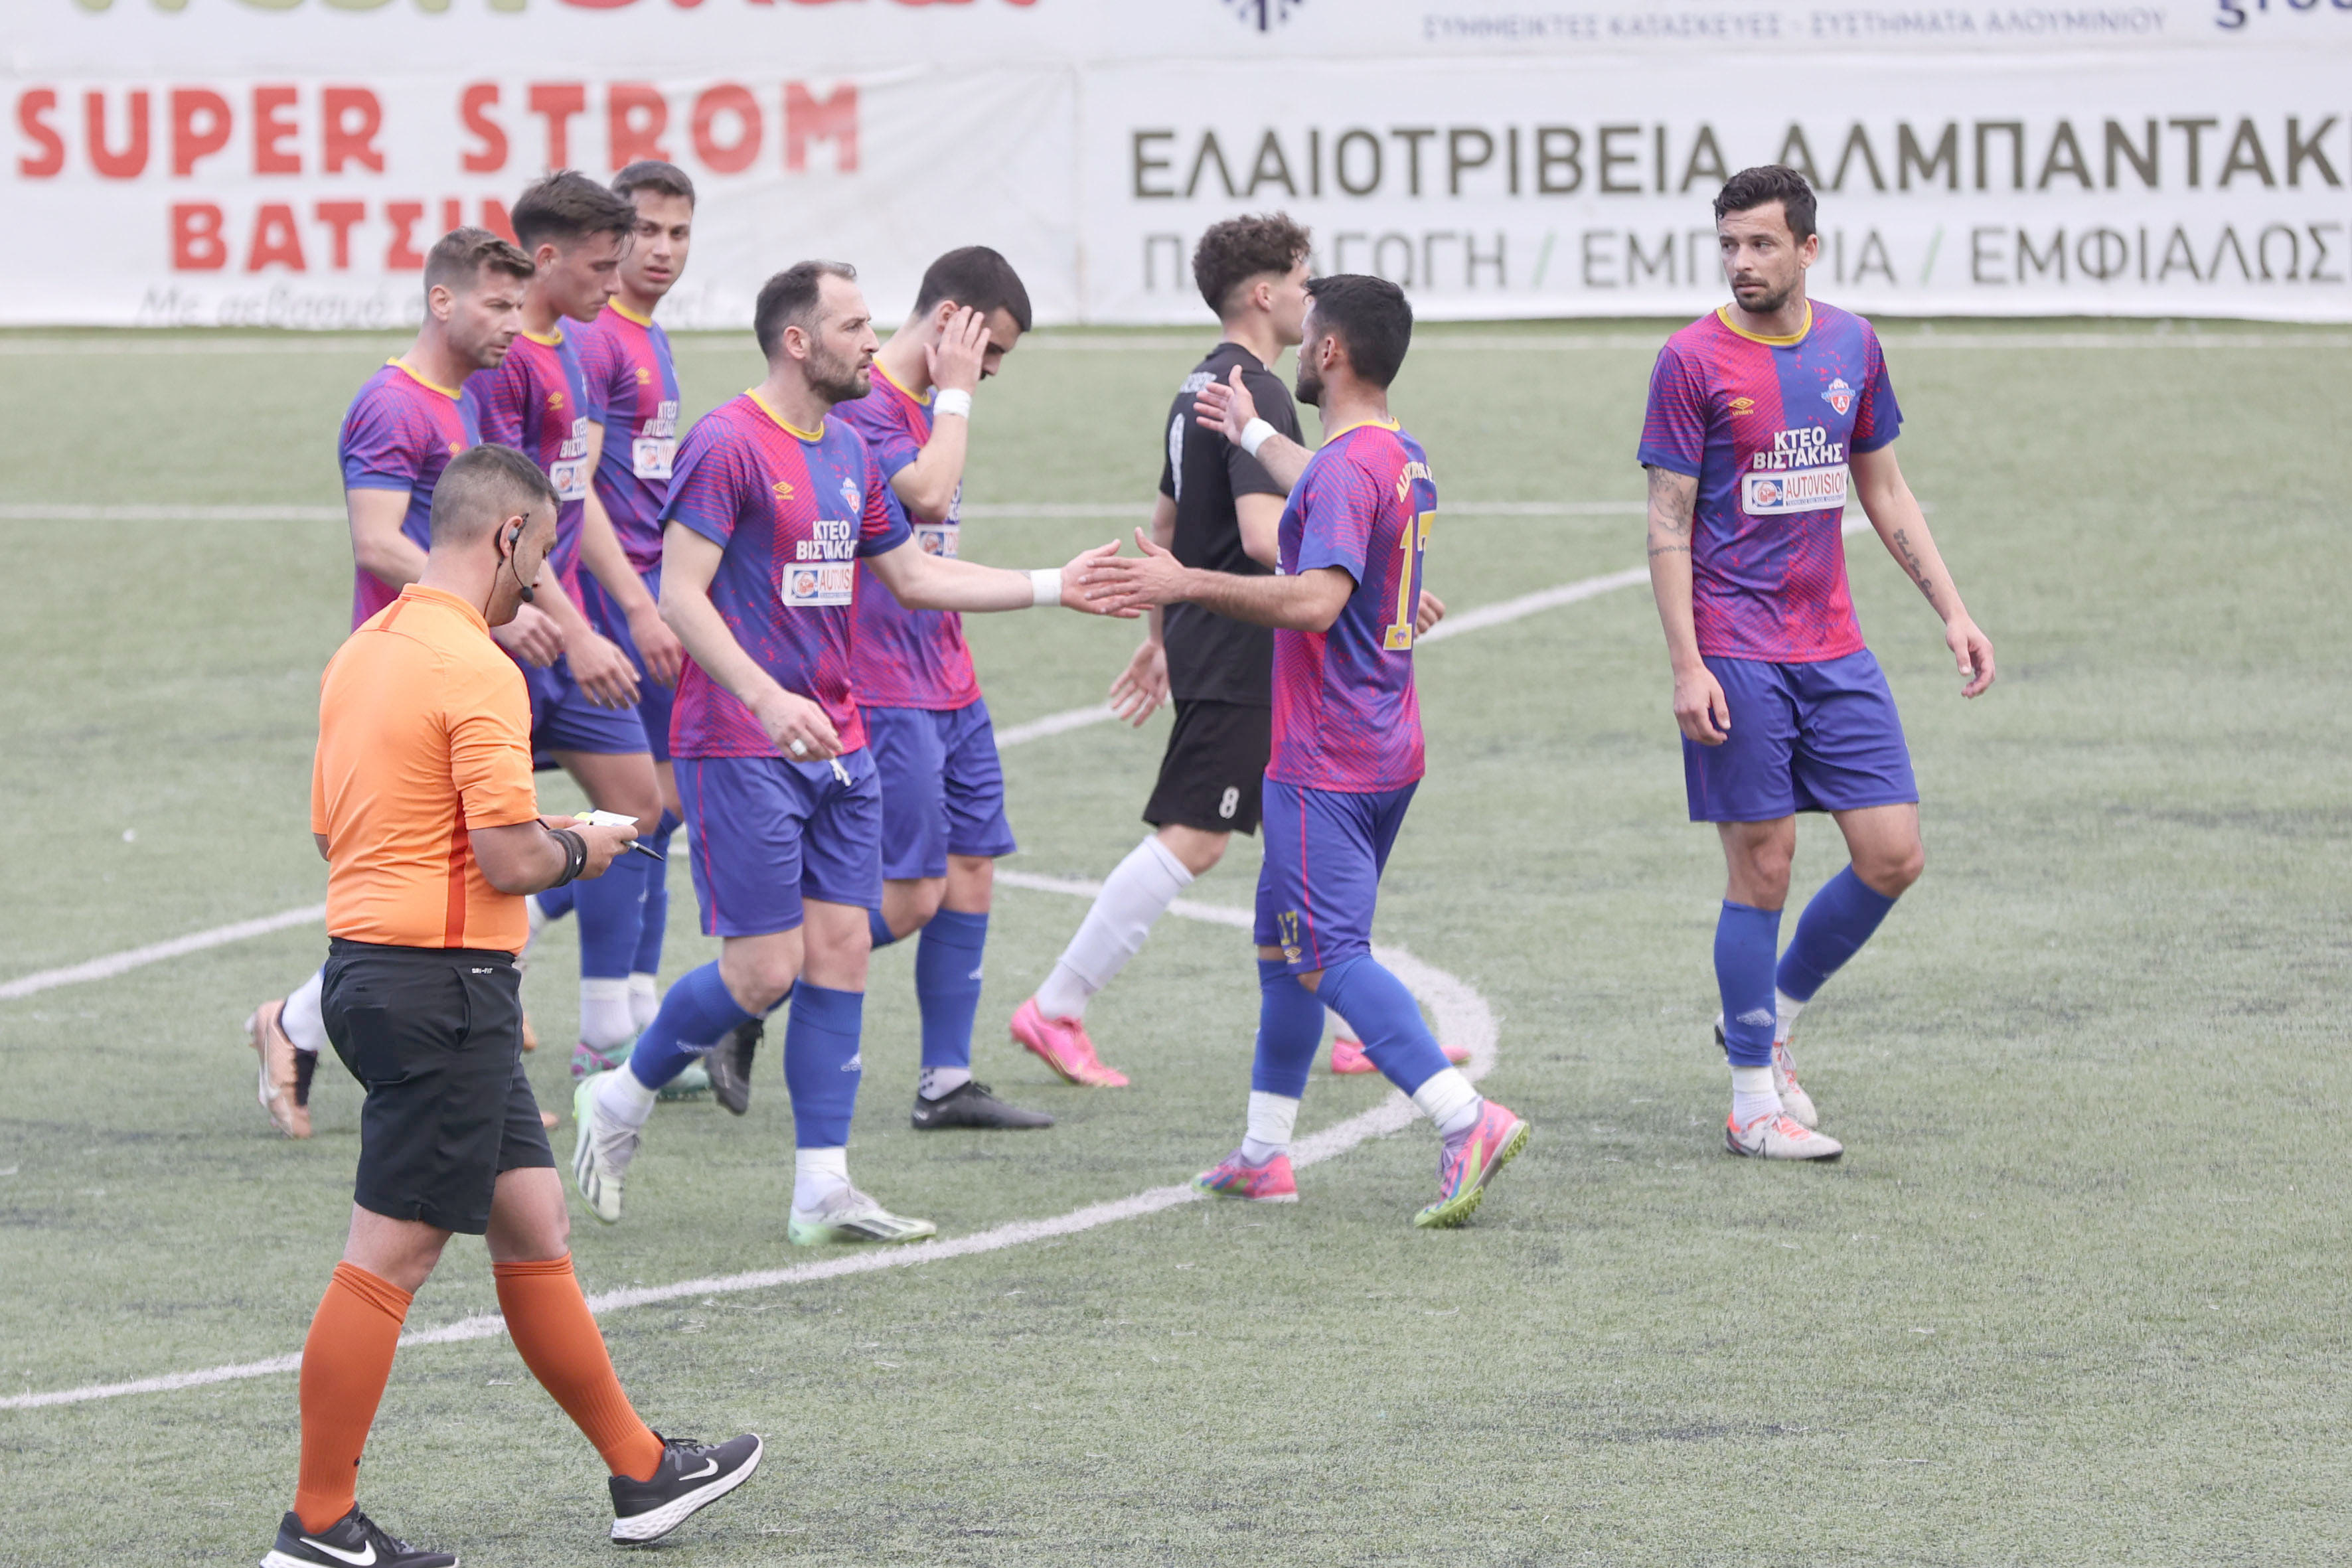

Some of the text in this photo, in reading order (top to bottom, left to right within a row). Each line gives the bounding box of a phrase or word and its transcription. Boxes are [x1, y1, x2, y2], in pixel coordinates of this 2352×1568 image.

[1607, 11, 1781, 39] ΚΑΤΑΣΚΕΥΕΣ
[1812, 9, 1978, 37] ΣΥΣΤΗΜΑΤΑ
[1987, 6, 2164, 35] ΑΛΟΥΜΙΝΙΟΥ
[17, 80, 860, 179] SUPER STROM
[1131, 116, 2352, 199] ΕΛΑΙΟΤΡΙΒΕΙΑ ΑΛΜΠΑΝΤΑΚ
[1144, 230, 1507, 290] ΠΓΩΓΗ
[1581, 226, 1899, 288] ΕΜΠΙΑ
[1969, 223, 2352, 285] ΕΜΦΙΑΛΩΣ
[1773, 426, 1827, 451] ΚΤΕΟ
[1753, 442, 1843, 470] ΒΙΣΤΑΚΗΣ
[1785, 471, 1845, 499] AUTOVISION
[812, 520, 851, 541] ΚΤΕΟ
[1218, 786, 1240, 819] 8
[1277, 910, 1298, 946] 17
